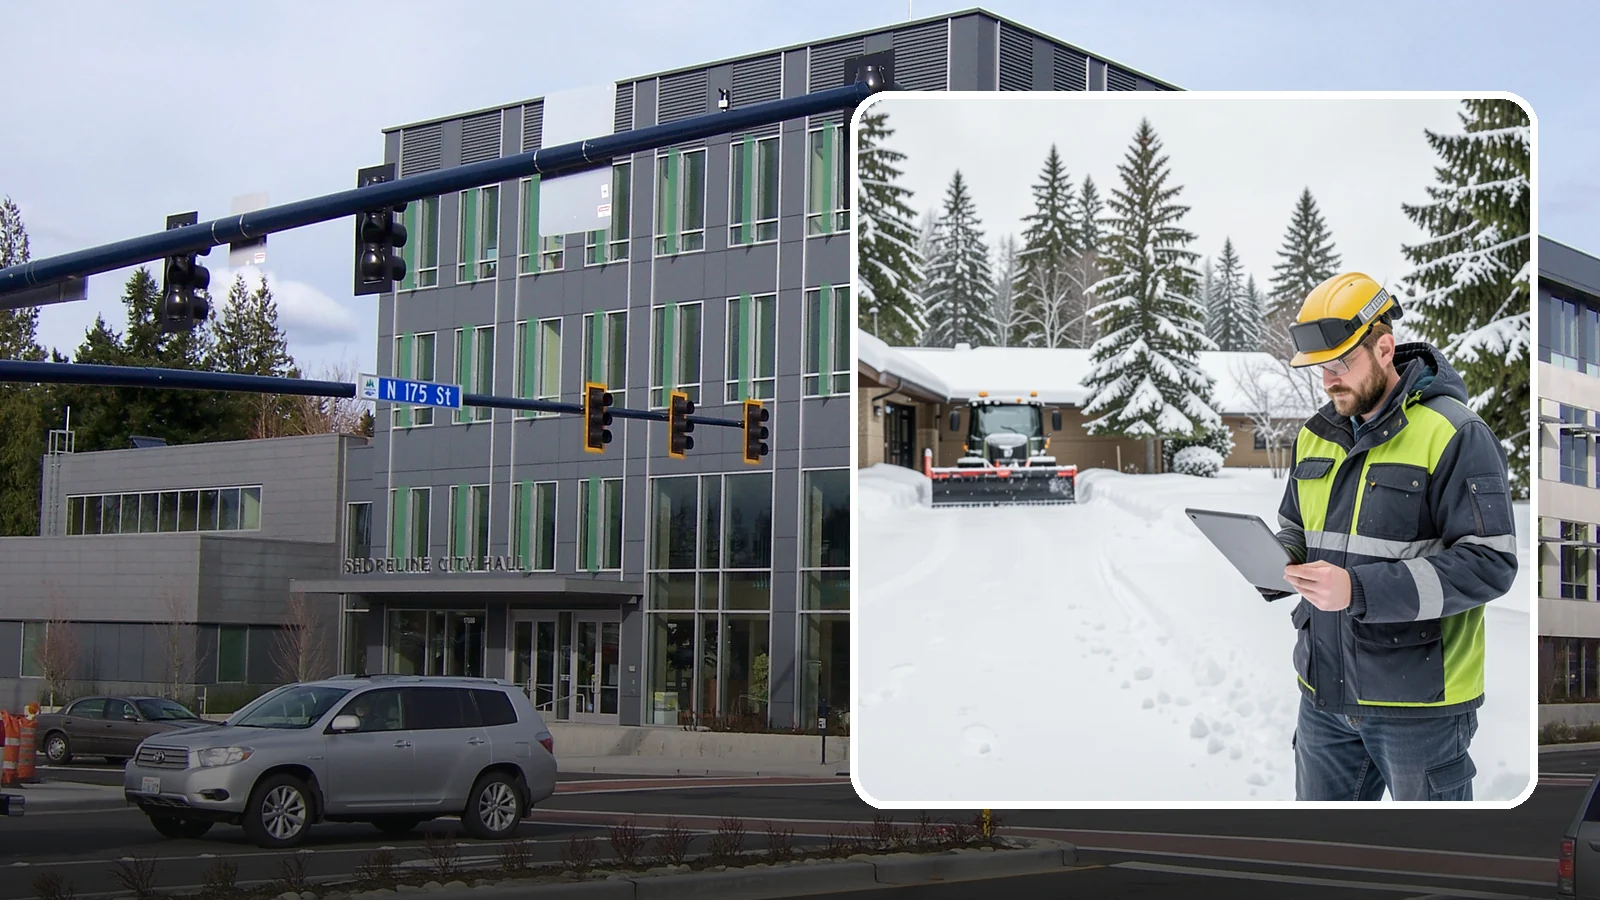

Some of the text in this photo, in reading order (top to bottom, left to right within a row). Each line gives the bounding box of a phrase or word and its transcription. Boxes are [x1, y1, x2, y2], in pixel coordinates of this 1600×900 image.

[387, 380, 451, 406] N 175 St
[344, 555, 526, 574] SHORELINE CITY HALL
